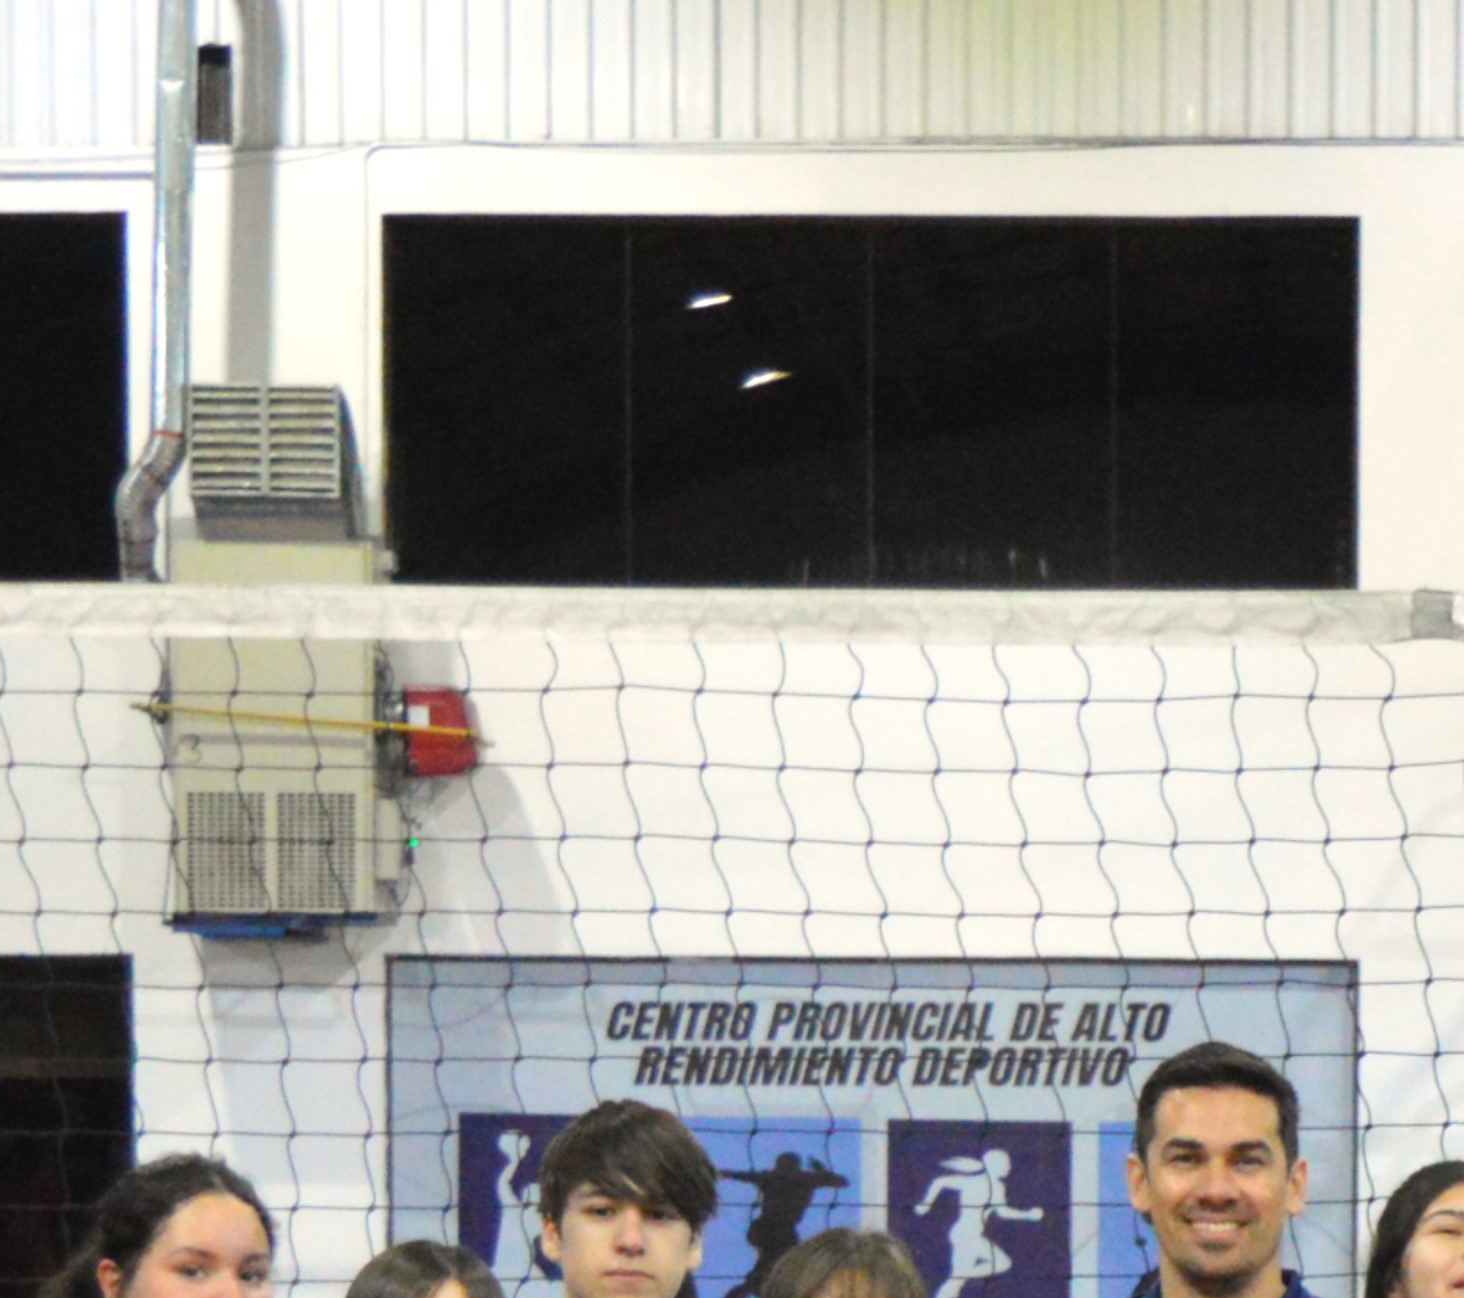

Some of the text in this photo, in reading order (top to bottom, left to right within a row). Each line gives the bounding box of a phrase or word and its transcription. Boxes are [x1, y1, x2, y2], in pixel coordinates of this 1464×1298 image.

[606, 1001, 1172, 1043] CENTRO PROVINCIAL DE ALTO
[634, 1046, 1132, 1087] RENDIMIENTO DEPORTIVO
